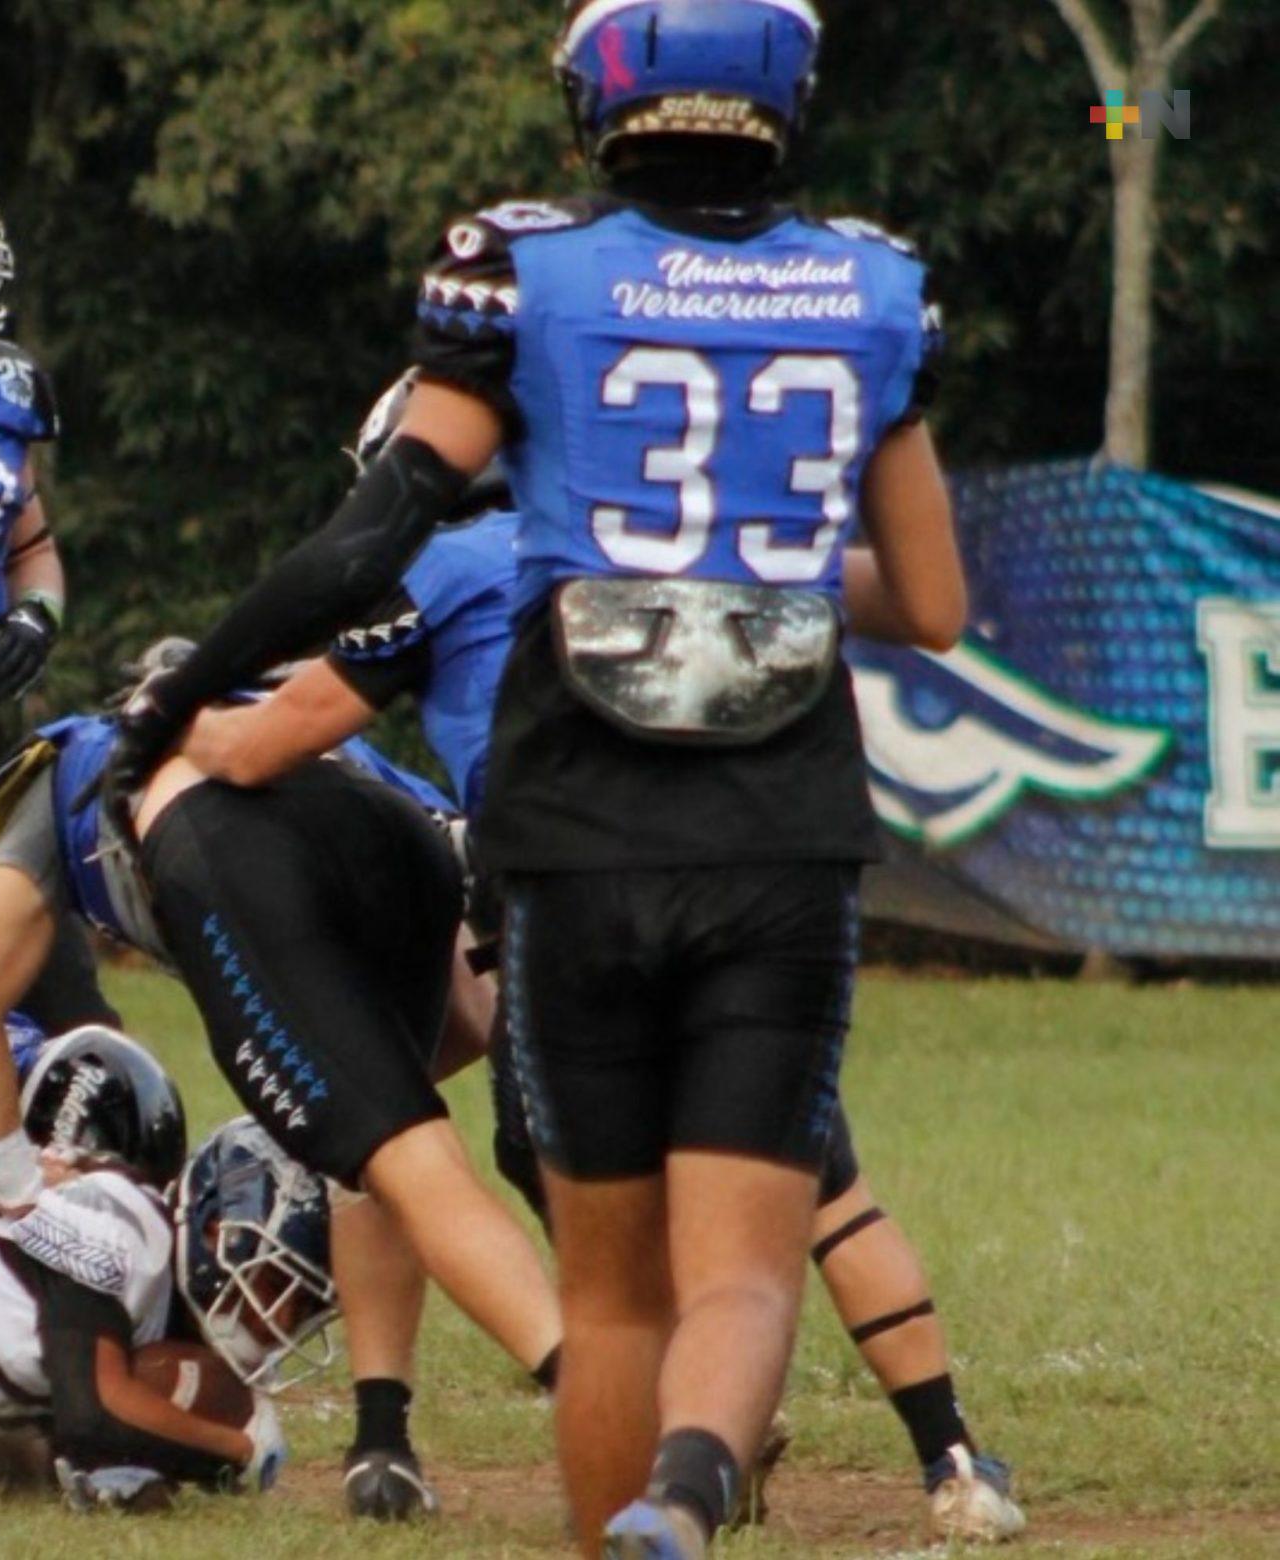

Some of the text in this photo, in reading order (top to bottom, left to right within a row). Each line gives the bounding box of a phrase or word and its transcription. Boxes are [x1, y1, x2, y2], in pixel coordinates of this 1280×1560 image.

[657, 250, 854, 288] Universidad
[612, 283, 861, 320] Veracruzana
[590, 347, 862, 583] 33
